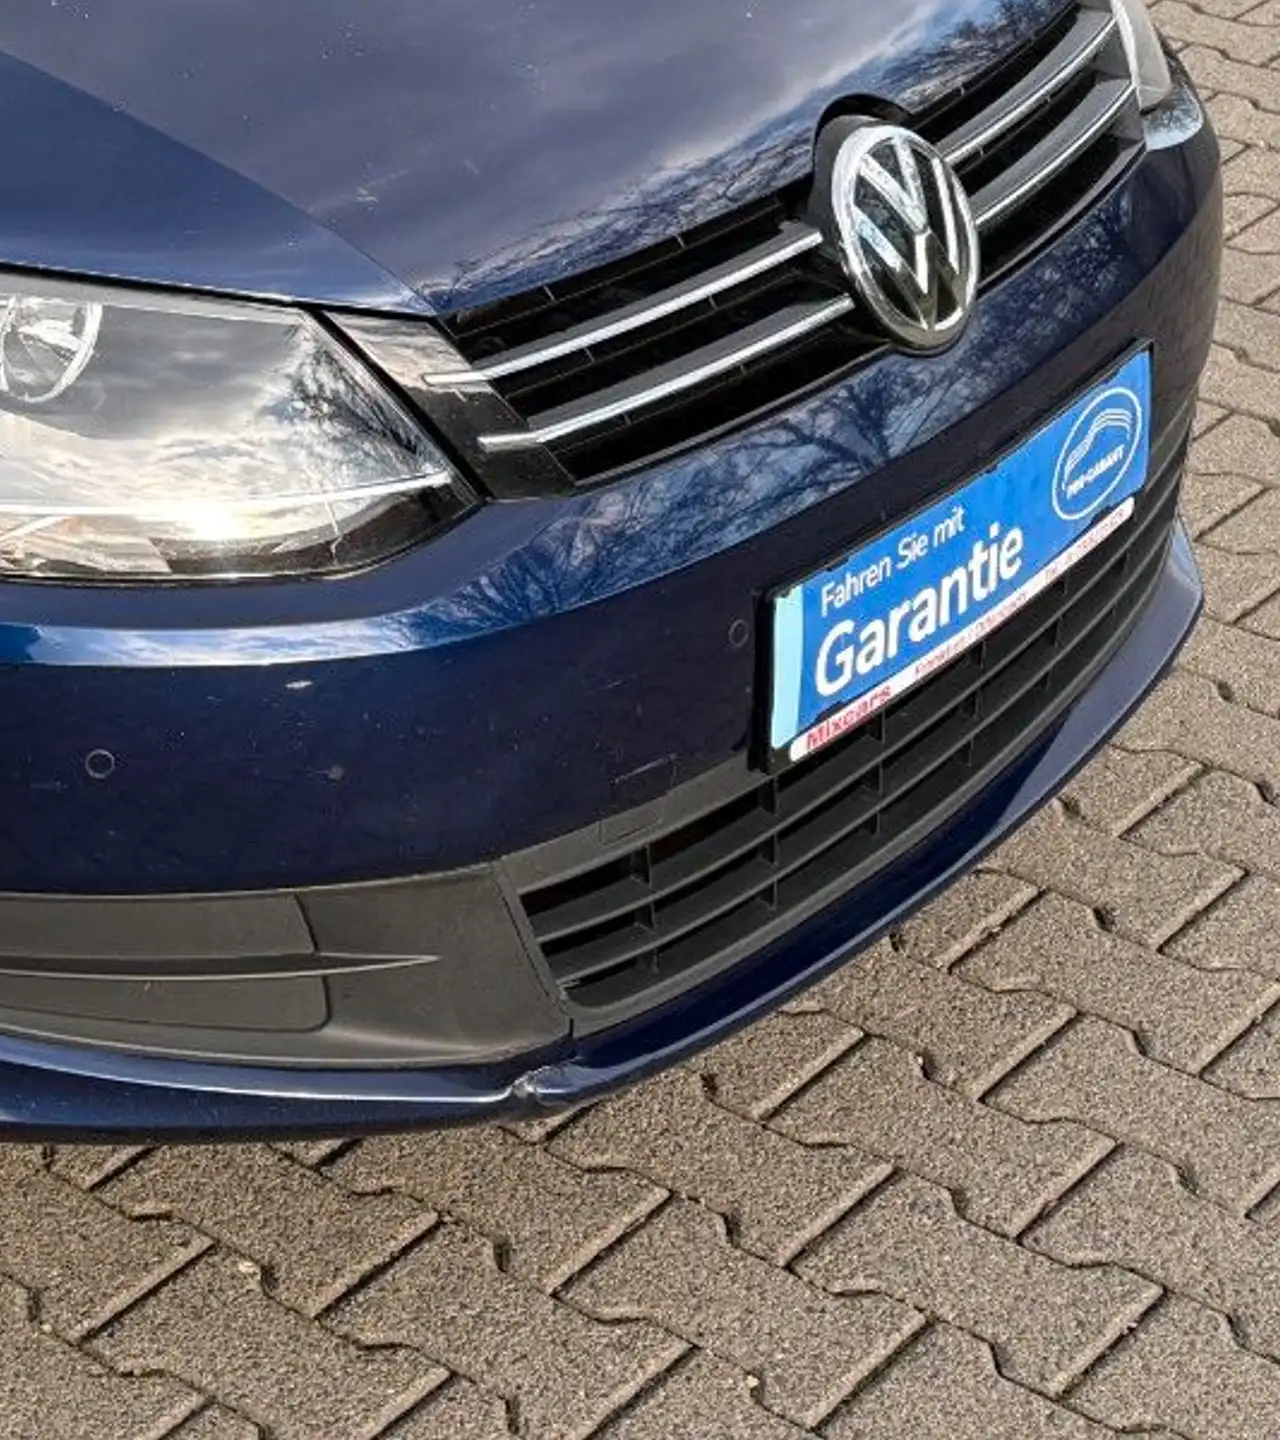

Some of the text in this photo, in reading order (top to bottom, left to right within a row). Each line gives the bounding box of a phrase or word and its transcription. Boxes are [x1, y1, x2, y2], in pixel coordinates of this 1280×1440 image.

[815, 521, 1024, 697] Garantie
[820, 505, 966, 618] Fahren Sie mit
